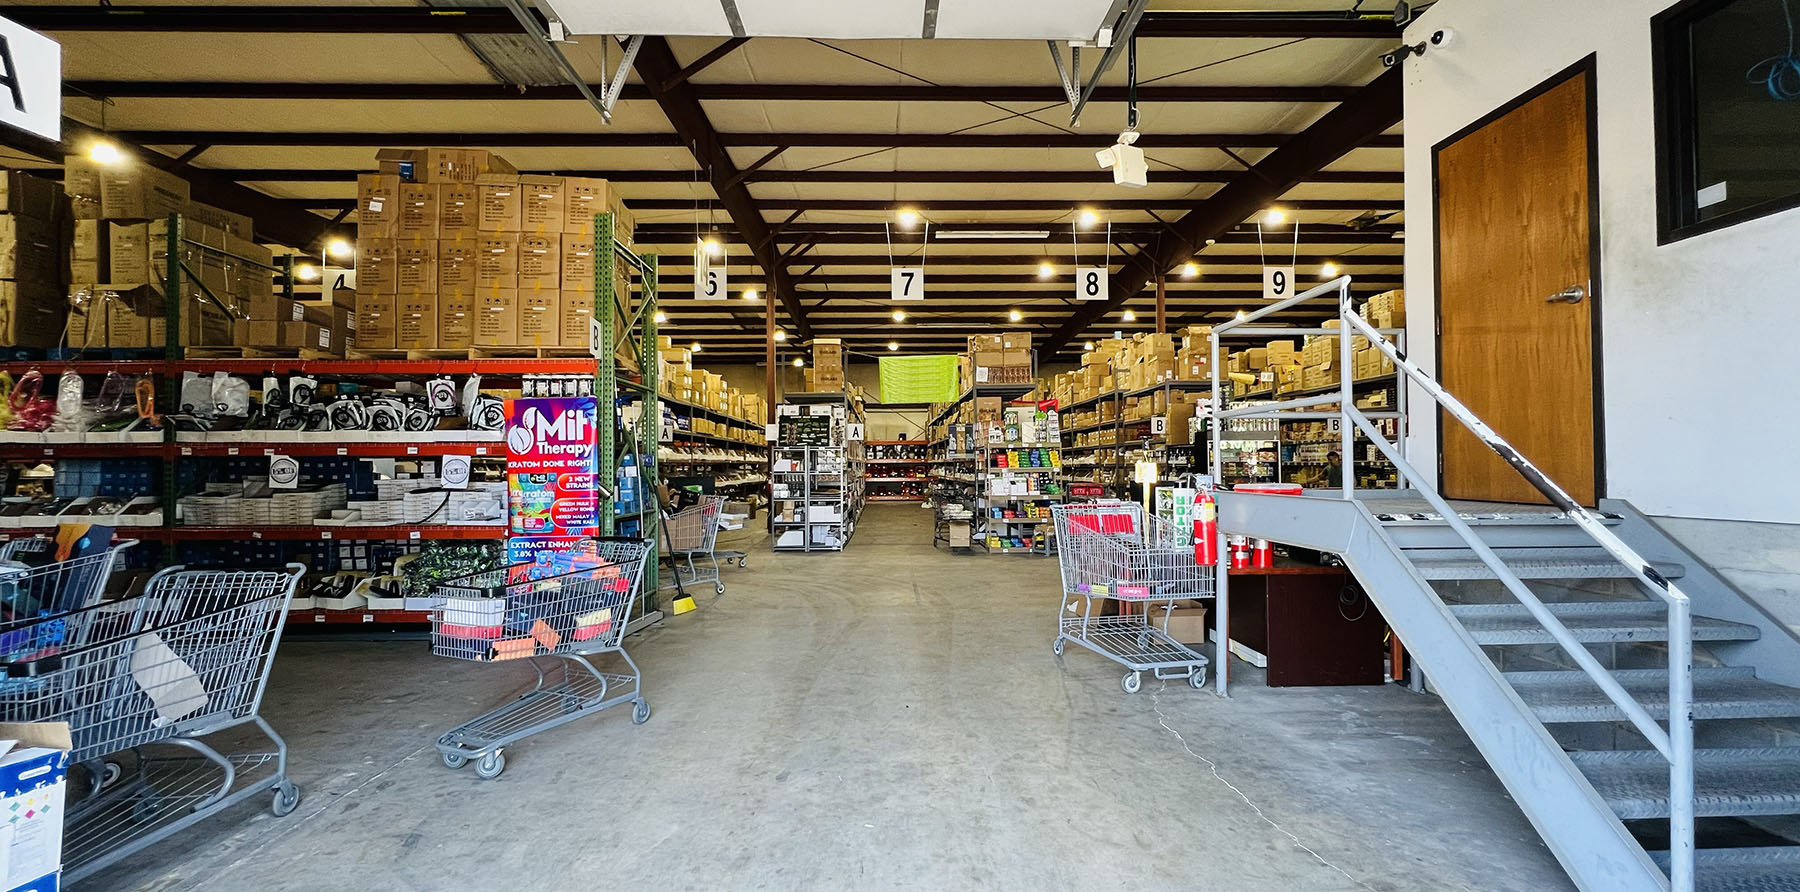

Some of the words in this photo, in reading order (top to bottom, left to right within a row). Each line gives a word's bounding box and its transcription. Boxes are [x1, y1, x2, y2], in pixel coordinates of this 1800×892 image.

[901, 272, 914, 296] 7
[1086, 271, 1099, 296] 8
[1273, 271, 1286, 295] 9
[536, 409, 588, 441] Mit
[1156, 419, 1163, 432] B
[1332, 419, 1340, 431] B
[661, 427, 669, 440] A
[852, 426, 860, 438] A
[536, 441, 592, 458] Therapy
[508, 460, 540, 468] KRATOM
[543, 460, 565, 468] DONE
[510, 541, 546, 549] EXTRACT
